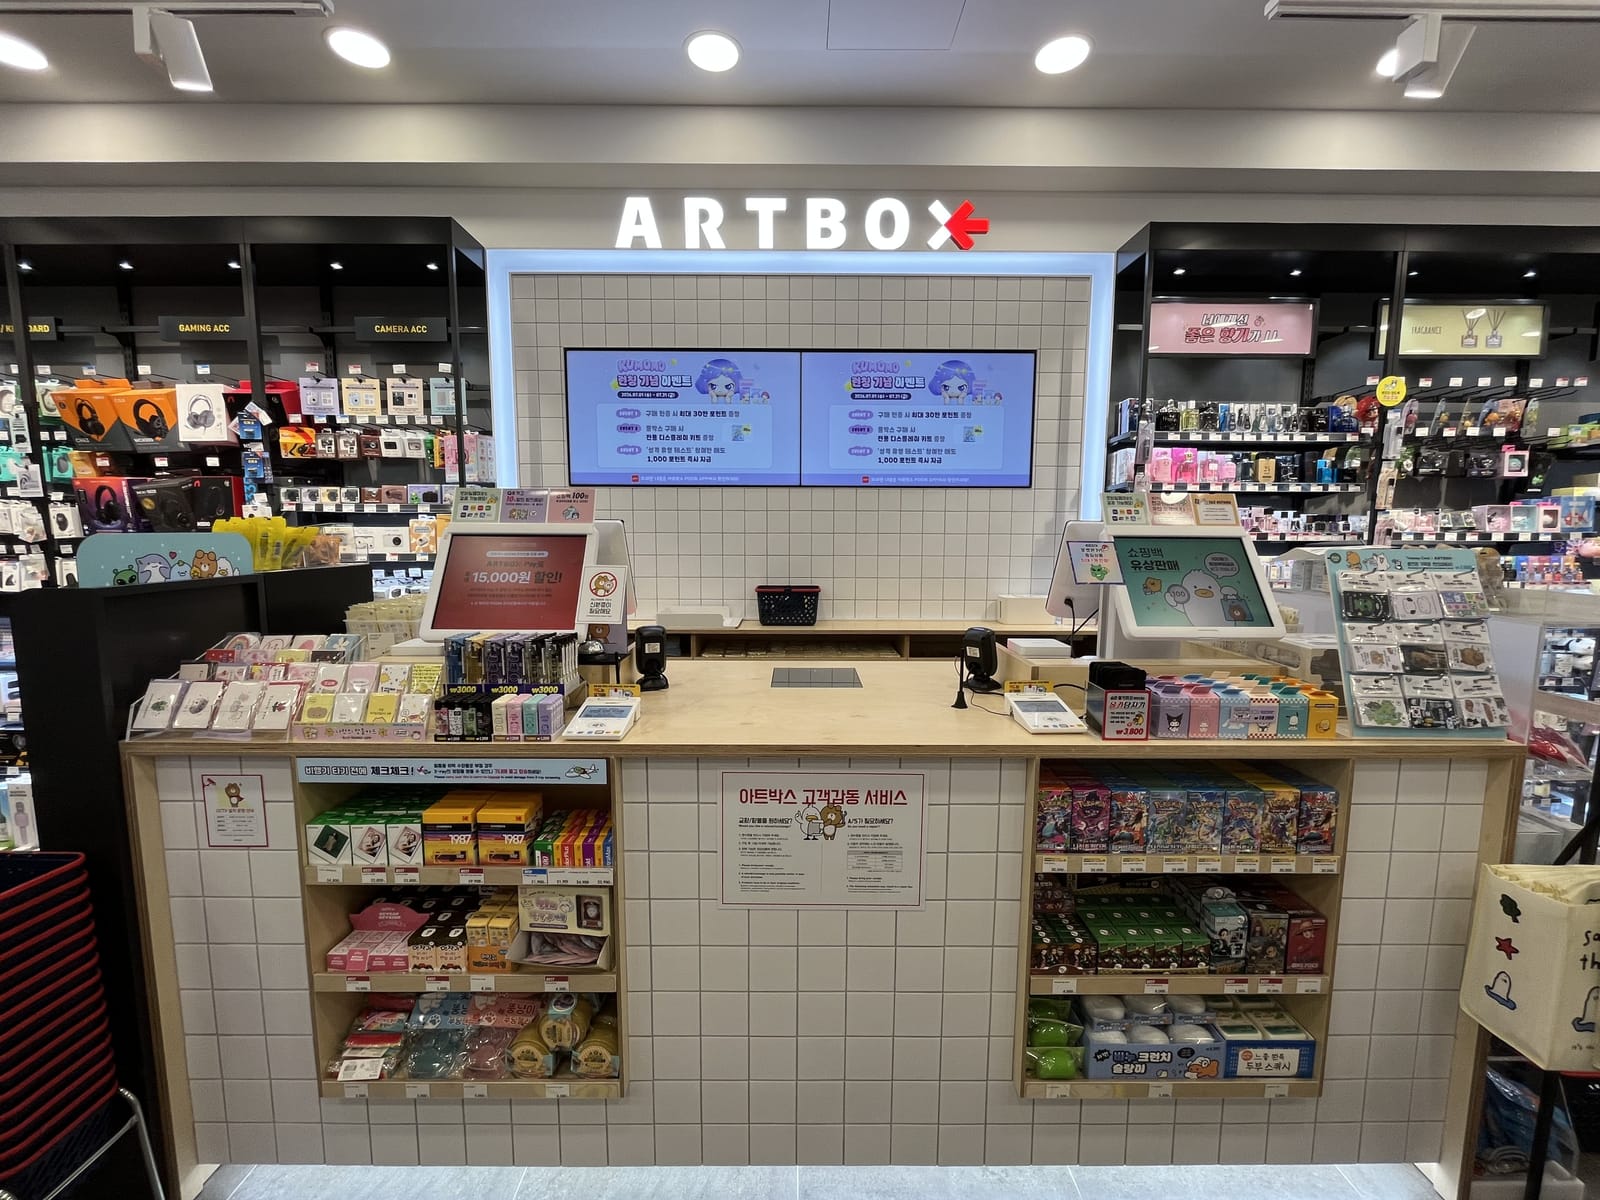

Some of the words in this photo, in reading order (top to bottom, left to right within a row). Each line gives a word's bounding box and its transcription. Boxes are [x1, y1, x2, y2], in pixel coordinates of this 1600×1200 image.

[615, 196, 989, 250] ARTBOX
[178, 324, 212, 333] GAMING
[213, 324, 230, 333] ACC
[374, 325, 409, 333] CAMERA
[410, 325, 428, 333] ACC
[1184, 327, 1215, 343] 좋은
[639, 374, 660, 388] 기념
[660, 374, 692, 388] 이벤트
[872, 376, 893, 389] 기념
[894, 376, 926, 389] 이벤트
[1128, 547, 1164, 558] 쇼핑백
[1130, 560, 1180, 572] 유상판매
[472, 571, 531, 584] 15,000원
[534, 571, 562, 584] 할인!
[305, 766, 330, 776] 비행기
[331, 766, 348, 776] 타기
[350, 766, 368, 776] 전에
[739, 788, 798, 805] 아트박스
[802, 789, 860, 806] 고객감동
[864, 790, 908, 806] 서비스
[448, 834, 472, 845] 1987
[502, 834, 525, 845] 1987
[1138, 1050, 1172, 1062] 크런치
